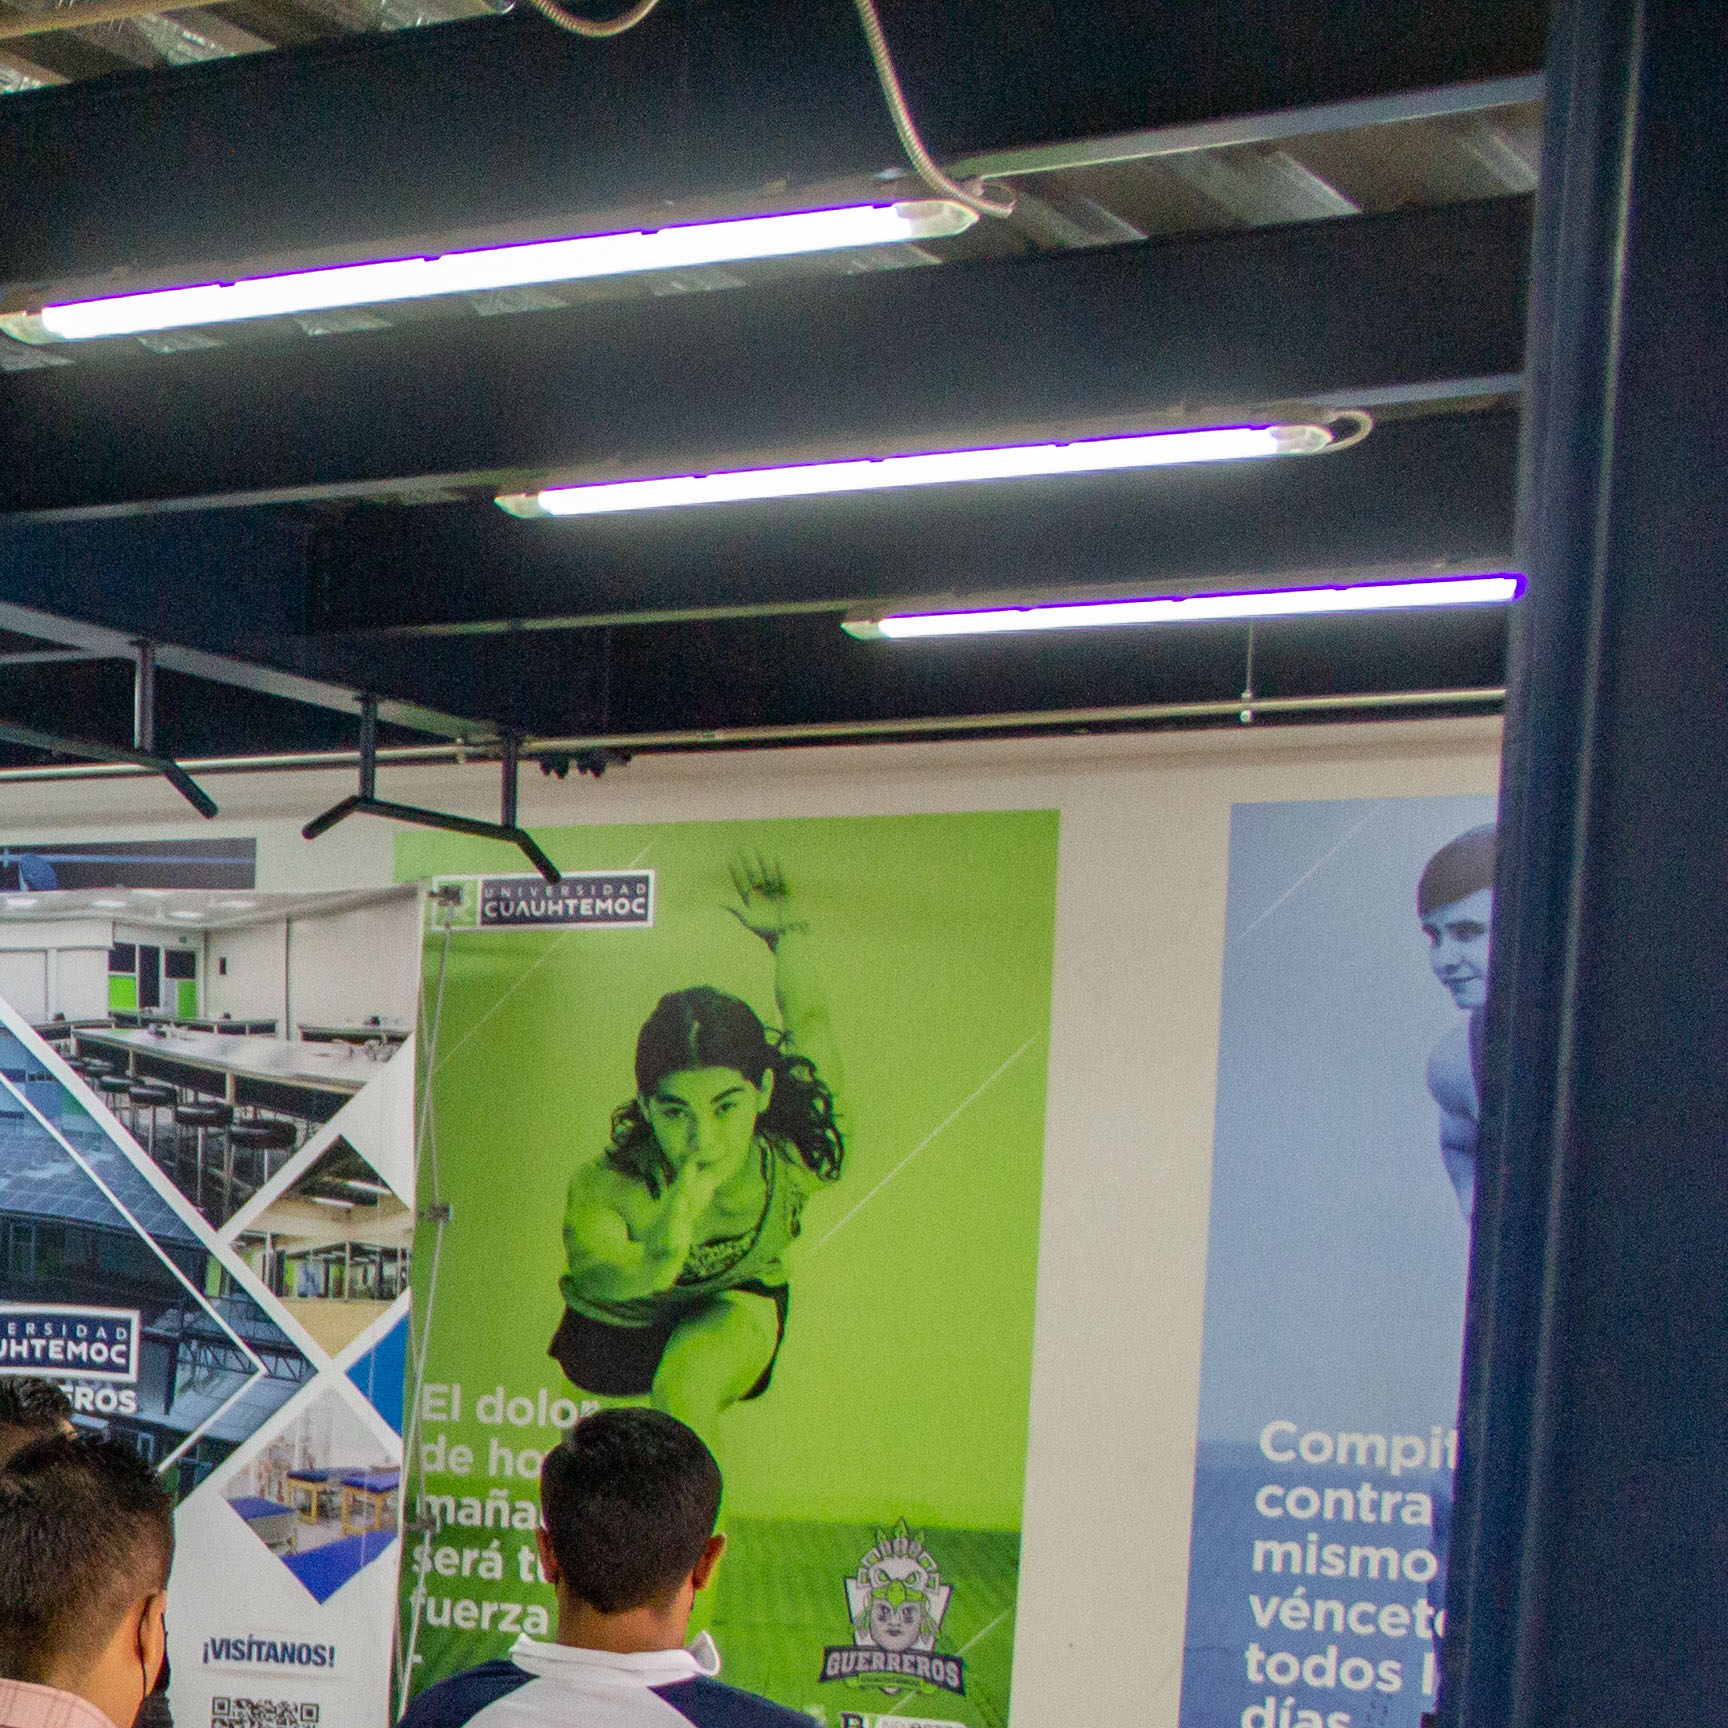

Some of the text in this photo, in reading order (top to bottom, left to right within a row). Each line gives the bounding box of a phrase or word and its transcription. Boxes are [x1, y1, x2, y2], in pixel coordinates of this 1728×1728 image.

[484, 882, 646, 898] UNIVERSIDAD
[484, 897, 646, 918] CUAUHTEMOC
[421, 1383, 461, 1422] El
[421, 1435, 543, 1479] de ho
[1258, 1419, 1459, 1477] Compit
[415, 1487, 546, 1531] maña
[1255, 1481, 1433, 1526] contra
[411, 1539, 504, 1581] será
[1251, 1532, 1439, 1583] mismo
[411, 1583, 550, 1636] fuerza
[202, 1633, 335, 1669] ¡VISÍTANOS!
[826, 1650, 960, 1688] GUERREROS
[1244, 1643, 1404, 1694] todos
